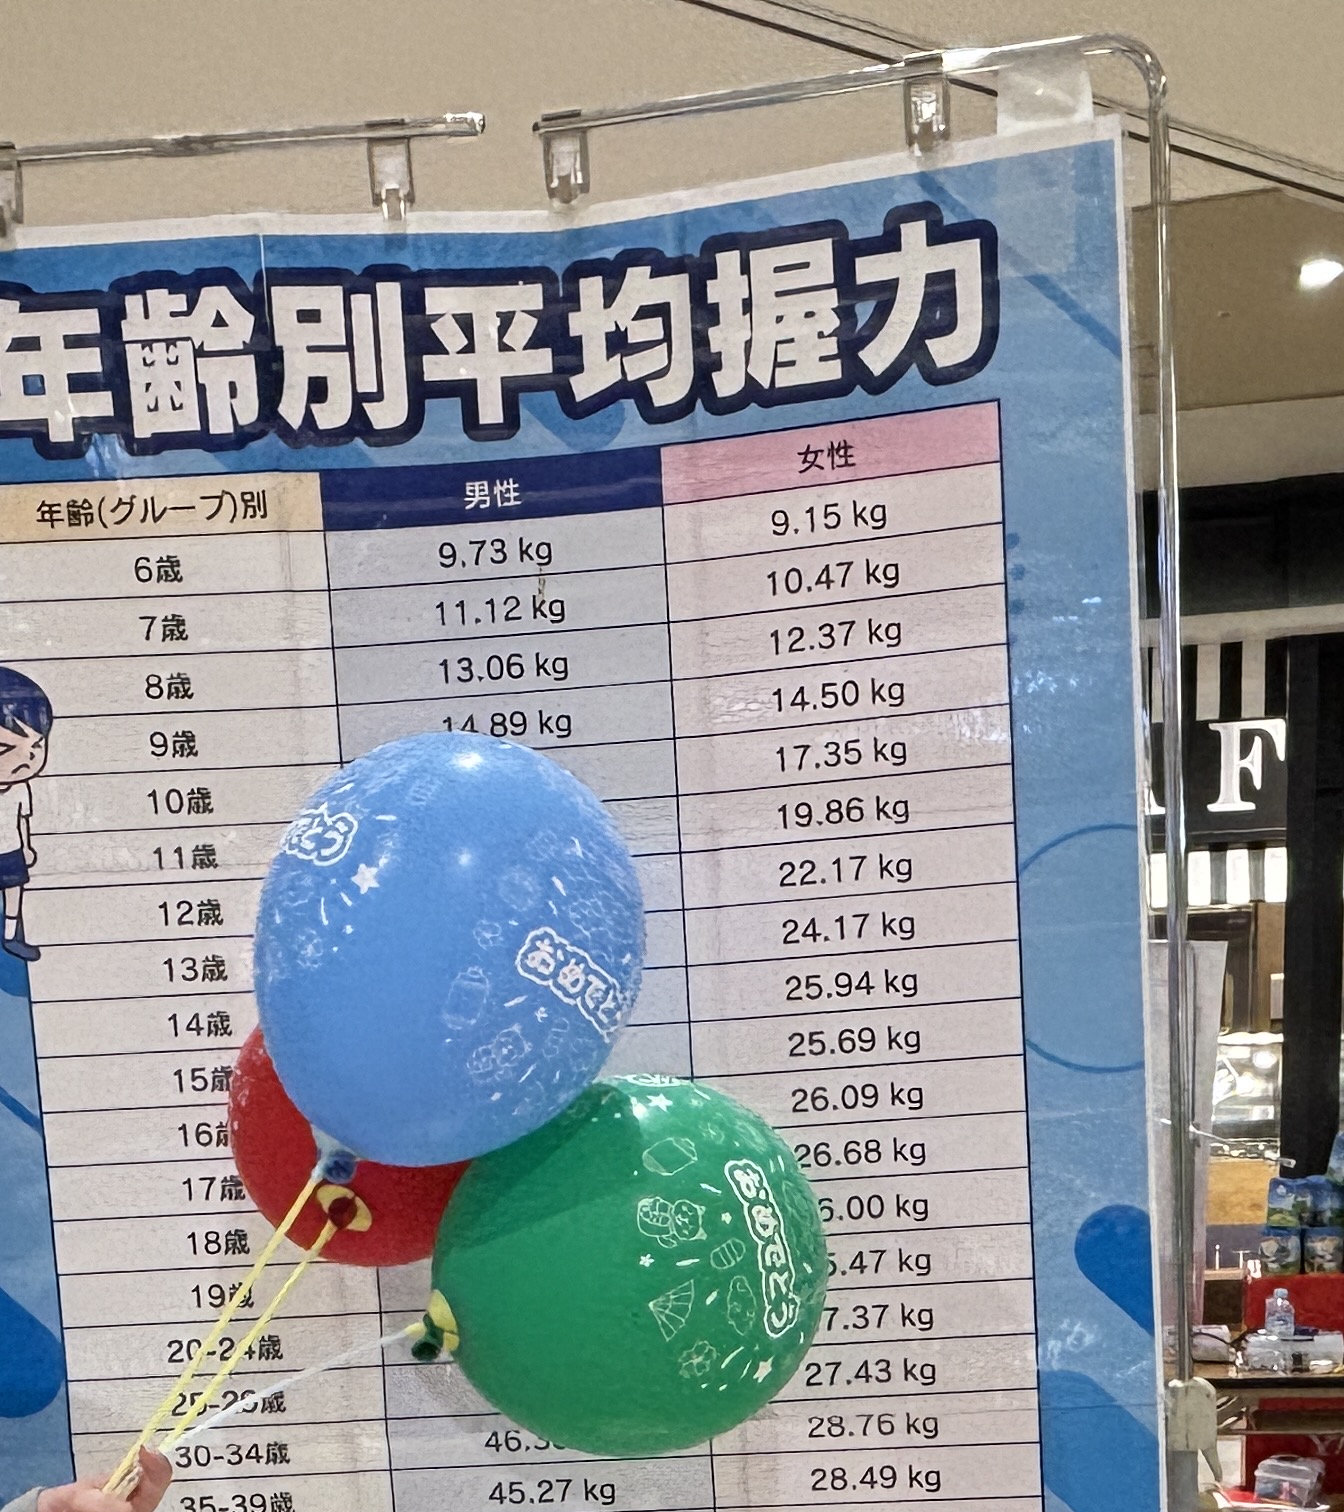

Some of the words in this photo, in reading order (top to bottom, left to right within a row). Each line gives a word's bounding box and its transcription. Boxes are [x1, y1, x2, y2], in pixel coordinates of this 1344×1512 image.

[796, 438, 857, 473] 女性
[464, 478, 522, 509] 男性
[772, 502, 844, 537] 9.15
[853, 499, 887, 531] kg
[134, 555, 183, 584] 6歳
[439, 537, 508, 569] 9.73
[519, 536, 552, 573] kg
[767, 560, 854, 597] 10.47
[865, 557, 899, 597] kg
[436, 595, 522, 627] 11.12
[532, 591, 565, 625] kg
[139, 614, 188, 642] 7歳
[770, 619, 856, 656] 12.37
[868, 617, 901, 656] kg
[439, 652, 525, 685] 13.06
[535, 651, 568, 685] kg
[145, 672, 194, 700] 8歳
[773, 679, 859, 713] 14.50
[871, 677, 904, 708] kg
[443, 710, 528, 739] 1489
[538, 709, 572, 739] kg
[150, 730, 198, 758] 9歳
[776, 736, 862, 773] 17.35
[873, 736, 907, 767] kg
[147, 787, 214, 815] 10歳
[778, 796, 866, 830] 19.86
[876, 794, 909, 825] kg
[153, 844, 221, 871] 11歳
[779, 854, 867, 888] 22.17
[879, 852, 912, 884] kg
[158, 899, 224, 926] 12歳
[782, 912, 870, 945] 24.17
[882, 910, 915, 942] kg
[163, 954, 228, 983] 13歳
[785, 970, 875, 1002] 25.94
[885, 968, 918, 999] kg
[168, 1011, 233, 1037] 14歳
[788, 1026, 876, 1058] 25.69
[887, 1024, 920, 1055] kg
[792, 1083, 879, 1114] 26.09
[891, 1081, 923, 1111] kg
[794, 1138, 884, 1170] 26.68
[893, 1136, 926, 1167] kg
[182, 1175, 246, 1202] 17歳
[818, 1193, 884, 1223] 6.00
[896, 1193, 928, 1222] kg
[187, 1229, 250, 1256] 18歳
[898, 1247, 931, 1277] kg
[823, 1303, 892, 1332] 7.37
[901, 1302, 934, 1333] kg
[805, 1358, 892, 1388] 27.43
[904, 1357, 936, 1387] kg
[808, 1412, 895, 1439] 28.76
[906, 1411, 938, 1440] kg
[175, 1441, 291, 1468] 30-34歳
[485, 1430, 564, 1452] 46.
[489, 1478, 573, 1506] 45.27
[582, 1477, 615, 1506] kg
[811, 1464, 897, 1492] 28.49
[909, 1464, 941, 1494] kg
